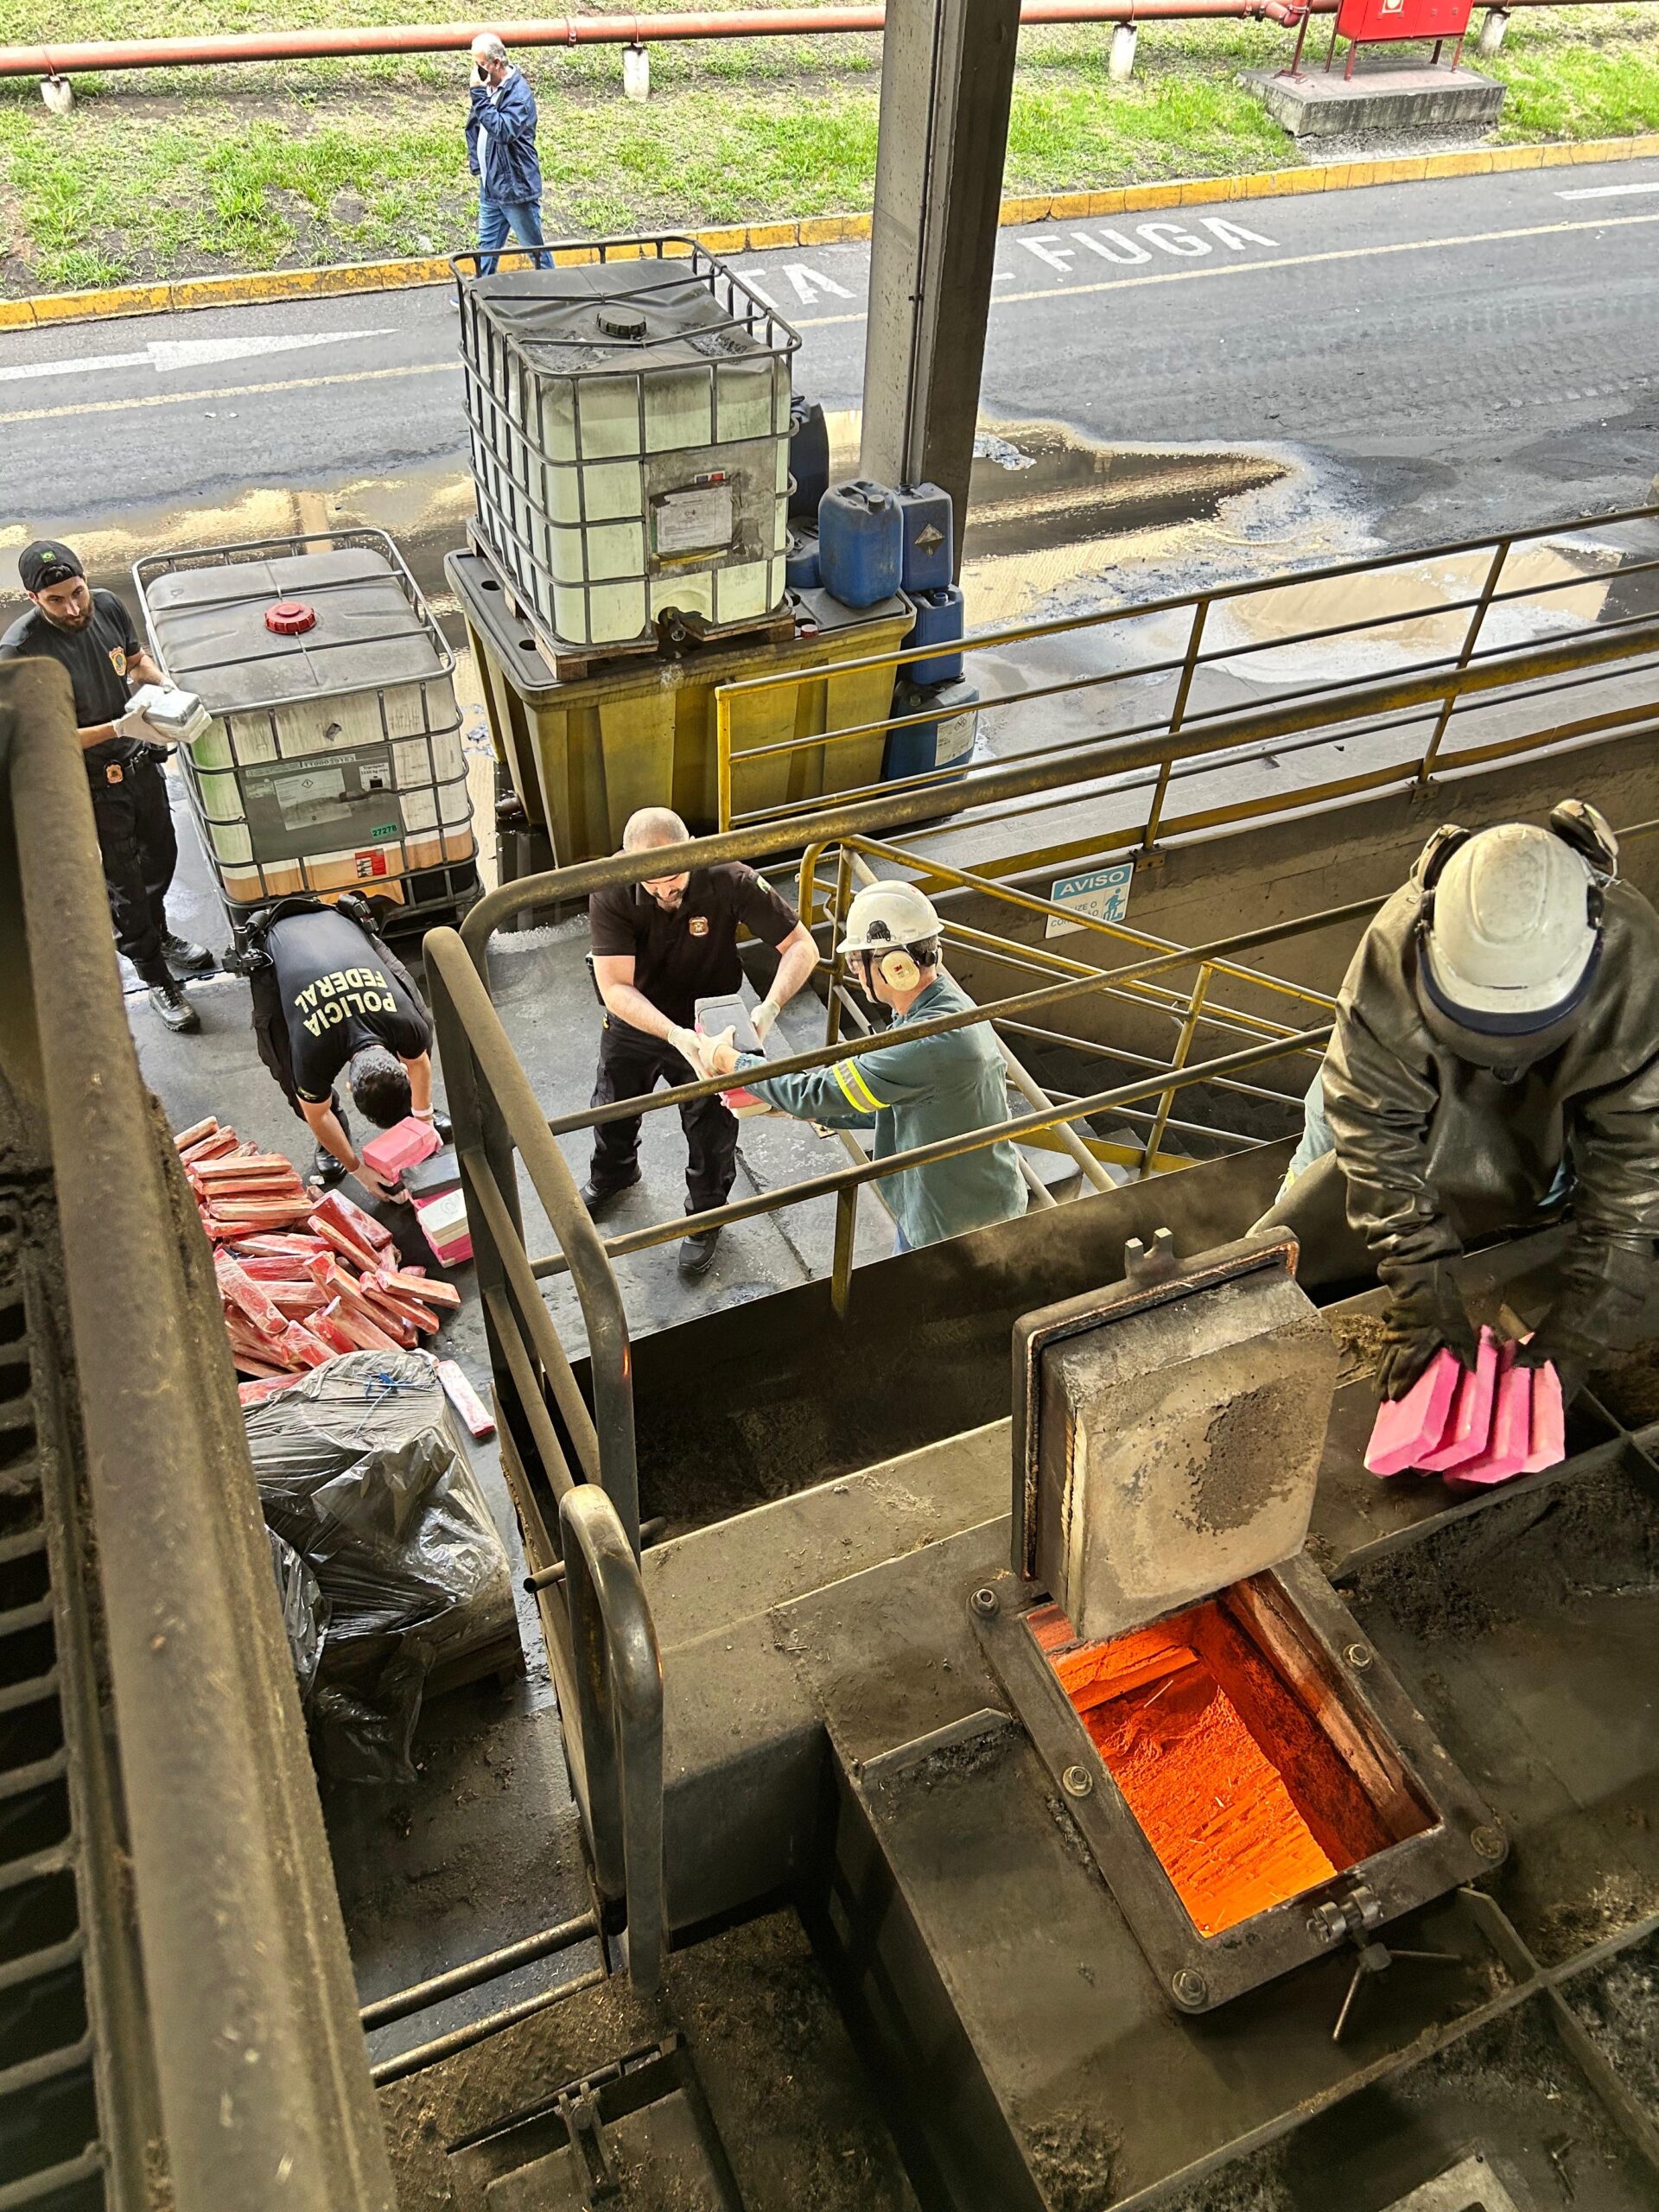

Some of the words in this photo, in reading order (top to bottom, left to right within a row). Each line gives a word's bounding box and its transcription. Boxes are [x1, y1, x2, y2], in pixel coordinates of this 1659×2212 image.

[1016, 217, 1281, 272] FUGA
[372, 824, 397, 836] 27278
[1059, 871, 1125, 896] AVISO
[294, 968, 388, 1014] FEDERAL
[302, 990, 397, 1037] POLICIA
